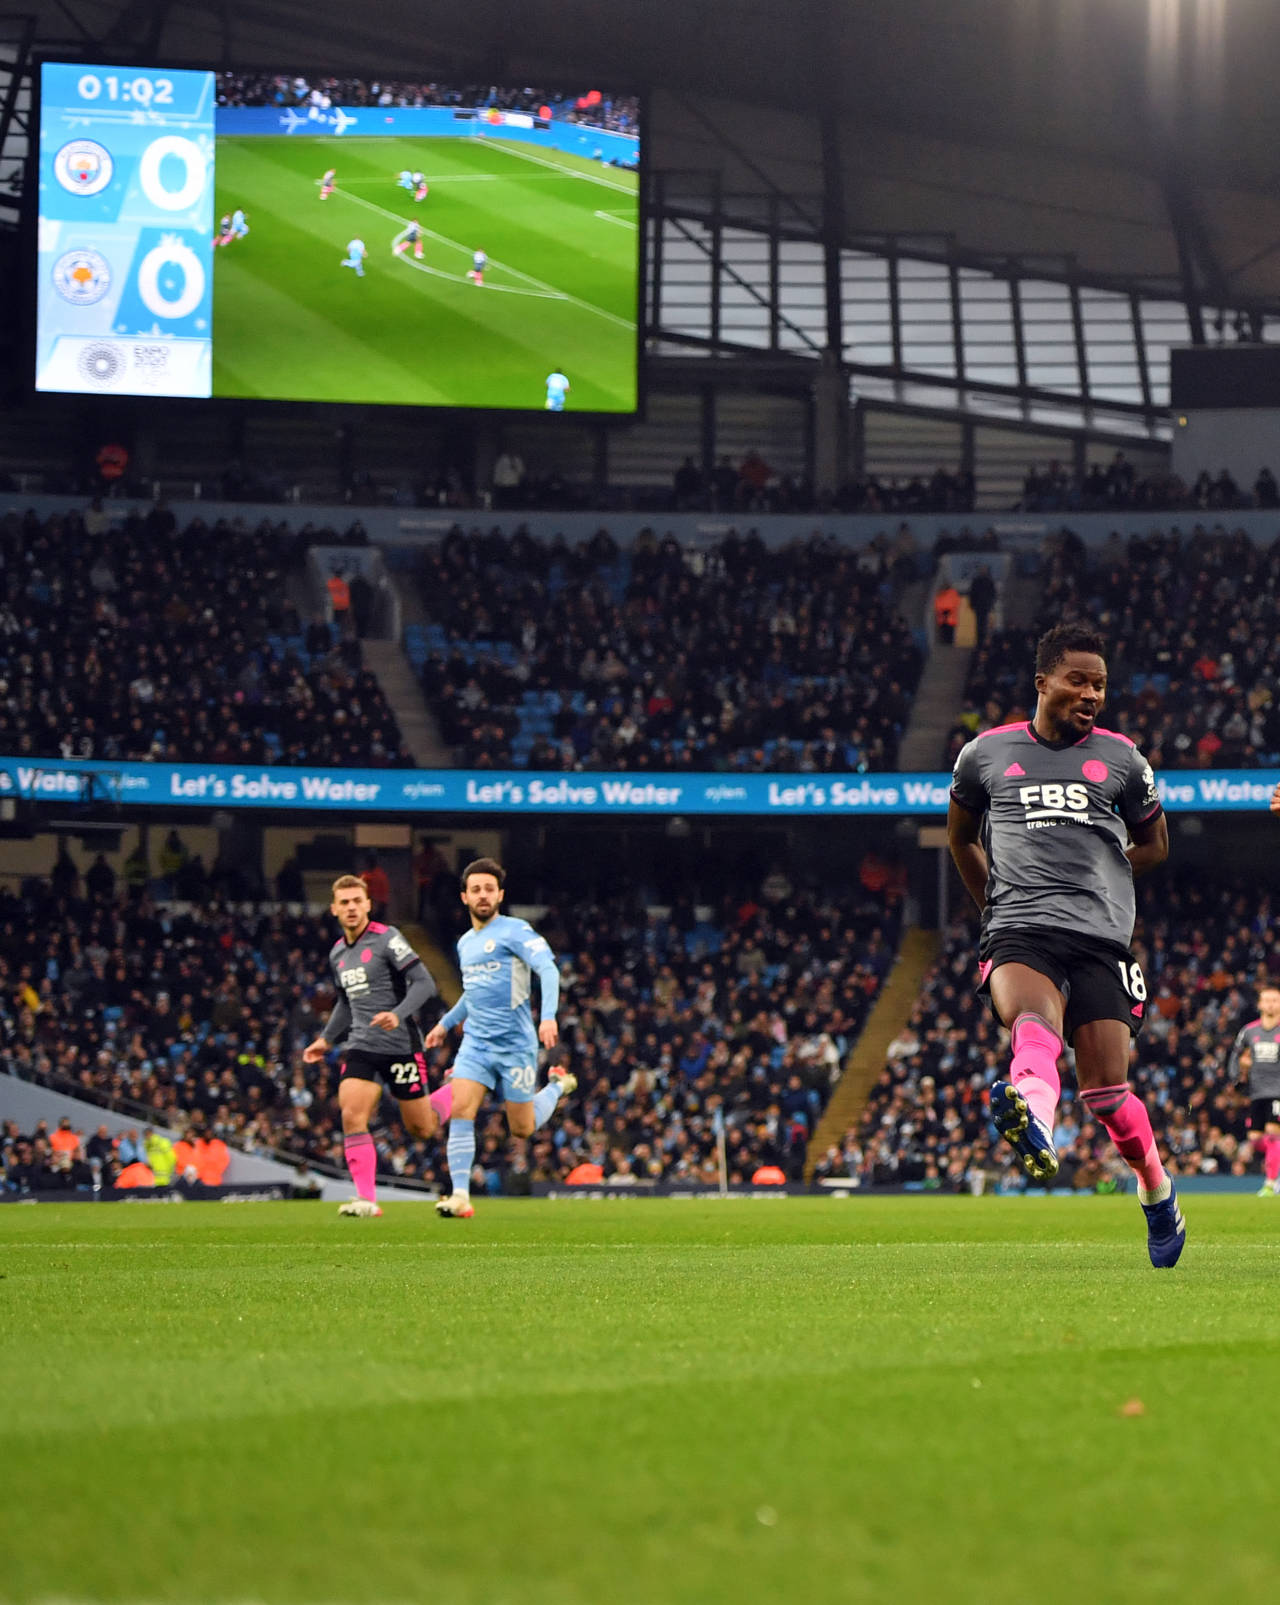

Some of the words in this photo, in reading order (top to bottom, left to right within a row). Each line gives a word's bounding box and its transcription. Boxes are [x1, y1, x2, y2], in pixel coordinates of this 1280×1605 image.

[78, 75, 174, 103] 01:02
[139, 135, 207, 211] 0
[138, 243, 205, 319] 0
[171, 772, 226, 797] Let's
[231, 774, 297, 799] Solve
[301, 777, 381, 801] Water
[466, 779, 523, 803] Let's
[528, 779, 598, 804] Solve
[601, 781, 683, 805] Water
[768, 782, 826, 806] Let's
[830, 780, 899, 806] Solve
[1019, 783, 1089, 811] FBS
[1157, 778, 1195, 802] lve
[340, 967, 367, 988] FBS
[1118, 961, 1147, 1001] 18
[390, 1063, 420, 1084] 22
[509, 1065, 536, 1089] 20
